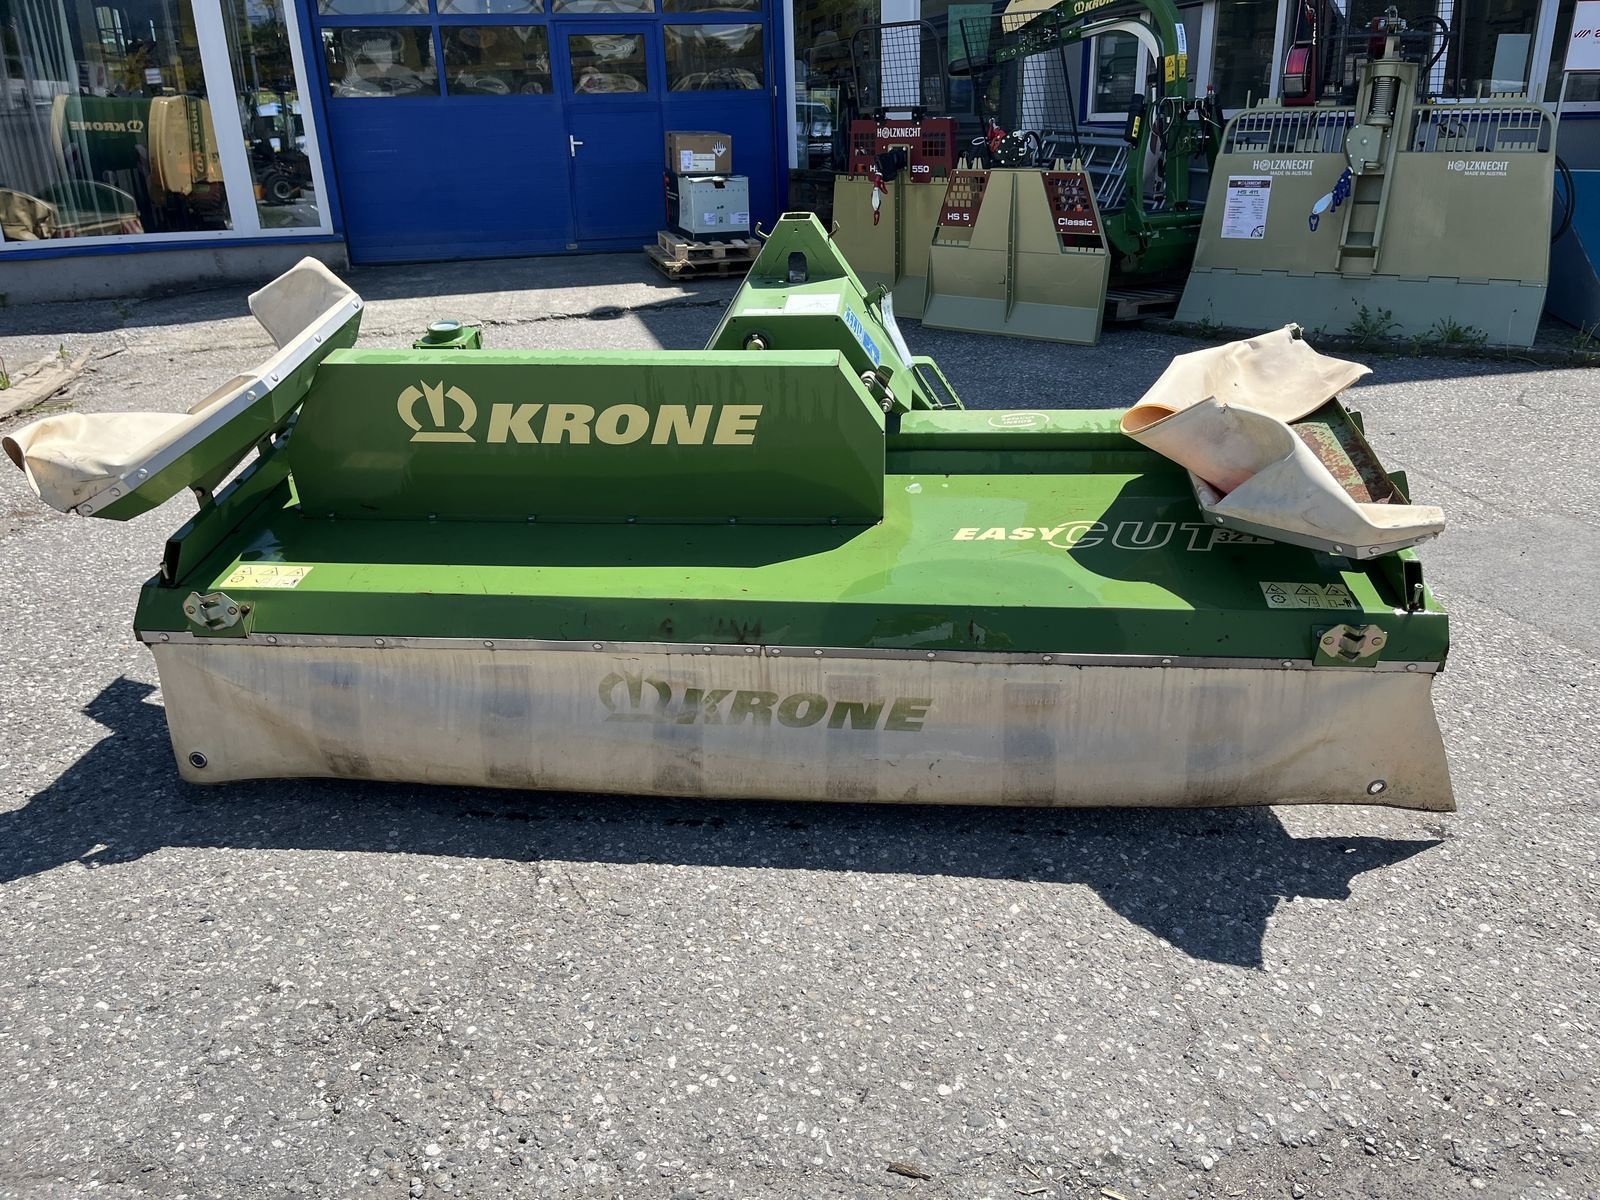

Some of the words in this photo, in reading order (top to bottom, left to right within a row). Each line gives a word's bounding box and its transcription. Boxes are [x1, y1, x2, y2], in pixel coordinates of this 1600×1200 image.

[877, 127, 921, 138] HOLZKNECHT
[912, 165, 930, 173] 550
[1253, 159, 1315, 171] HOLZKNECHT
[1448, 160, 1509, 171] HOLZKNECHT
[947, 213, 960, 221] HS
[962, 213, 970, 221] 5
[1058, 217, 1093, 227] Classic
[485, 403, 763, 445] KRONE
[677, 688, 932, 731] KRONE
